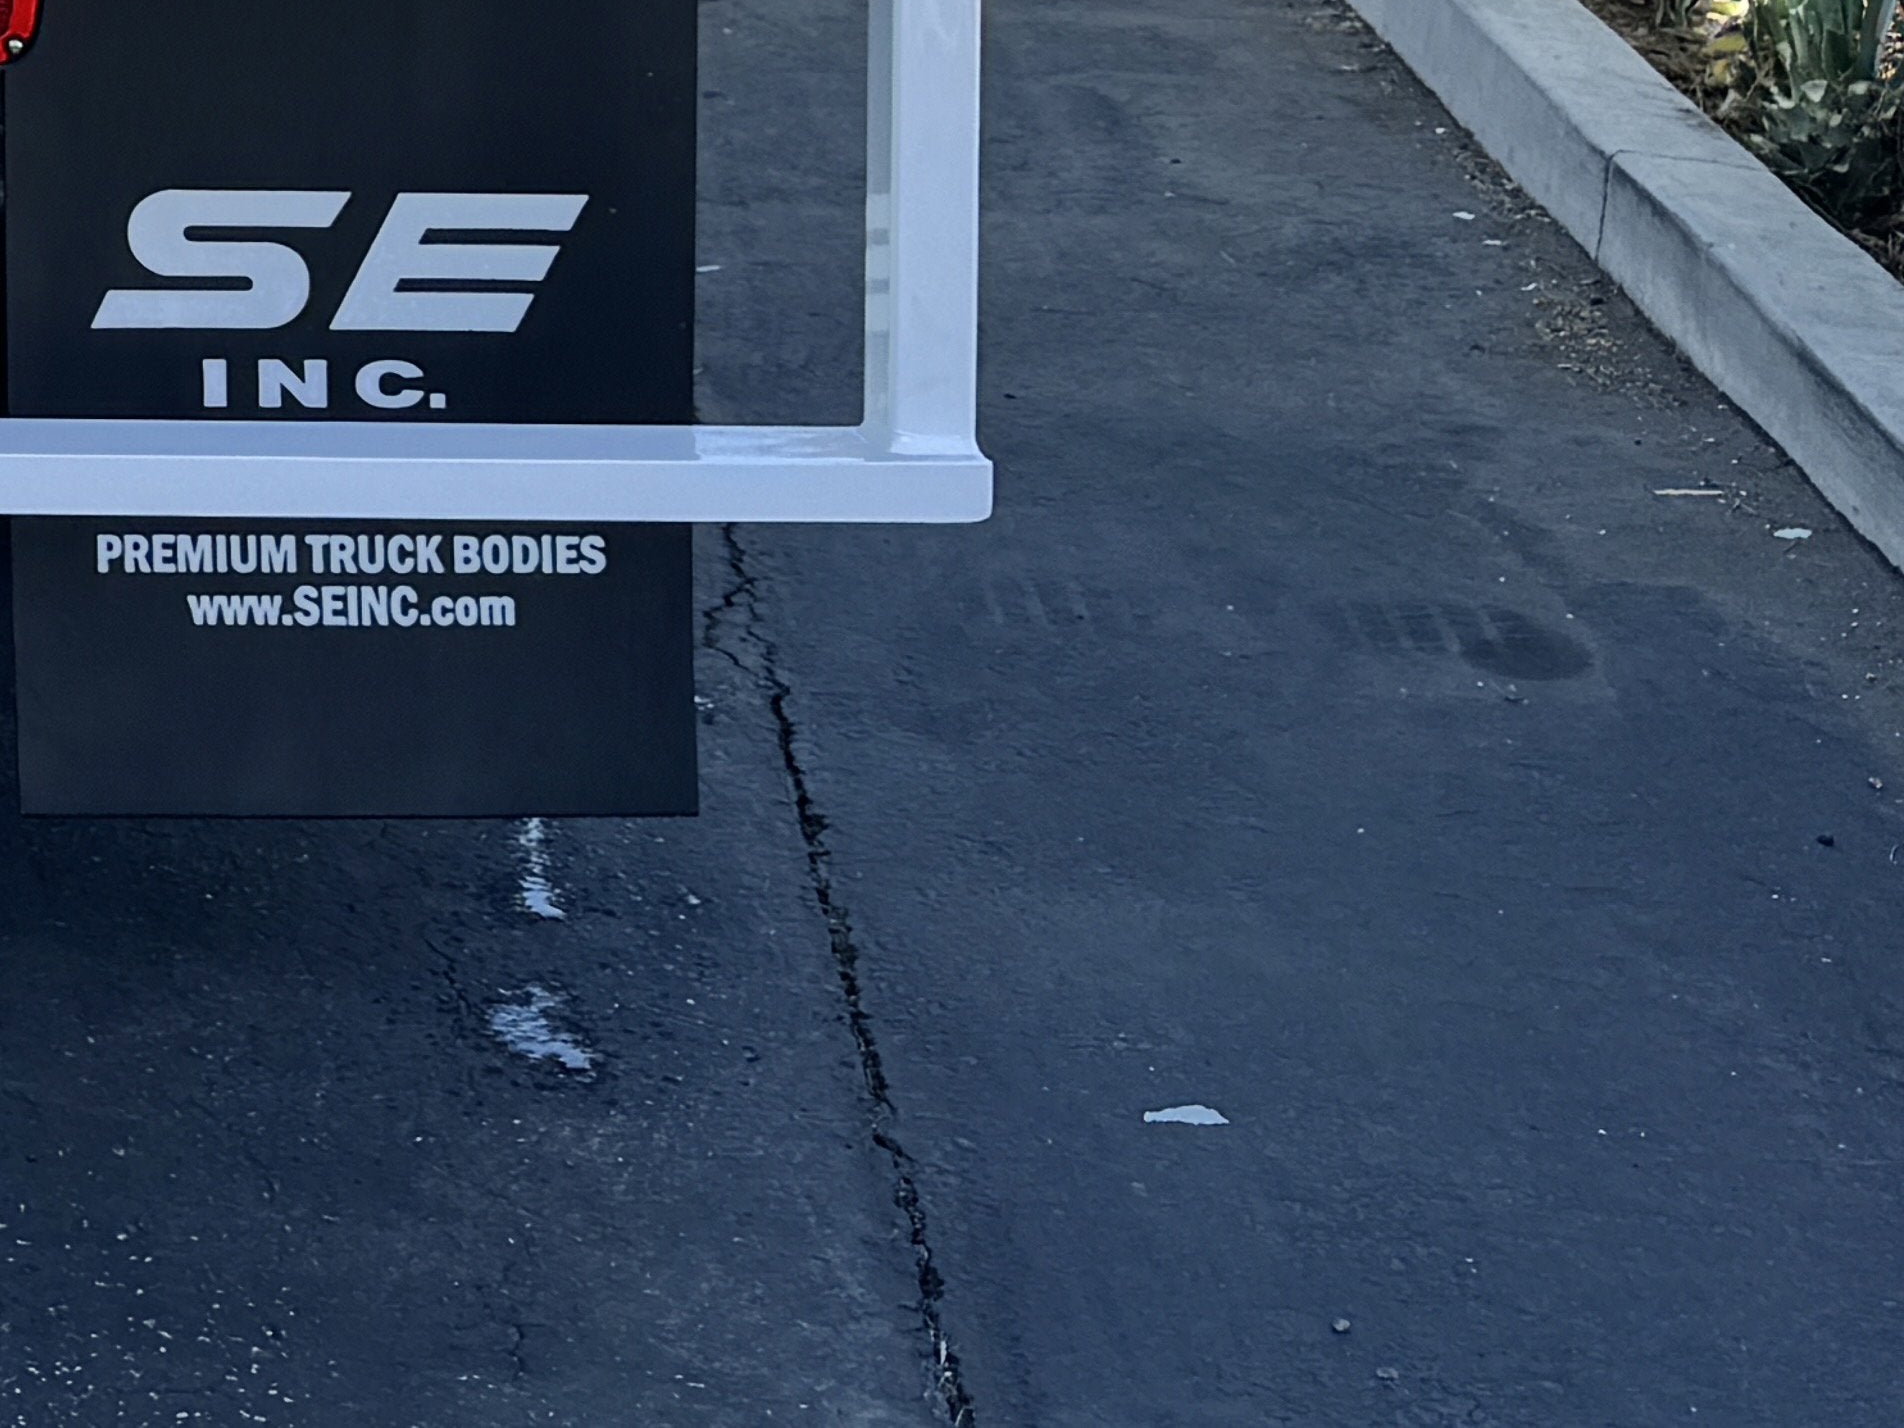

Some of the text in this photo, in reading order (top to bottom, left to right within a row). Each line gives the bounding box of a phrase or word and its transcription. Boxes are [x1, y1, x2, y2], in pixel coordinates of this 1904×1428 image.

[90, 189, 590, 333] SE
[202, 358, 447, 409] INC.
[95, 534, 607, 575] PREMIUM TRUCK BODIES
[187, 585, 516, 627] www.SEINC.com
